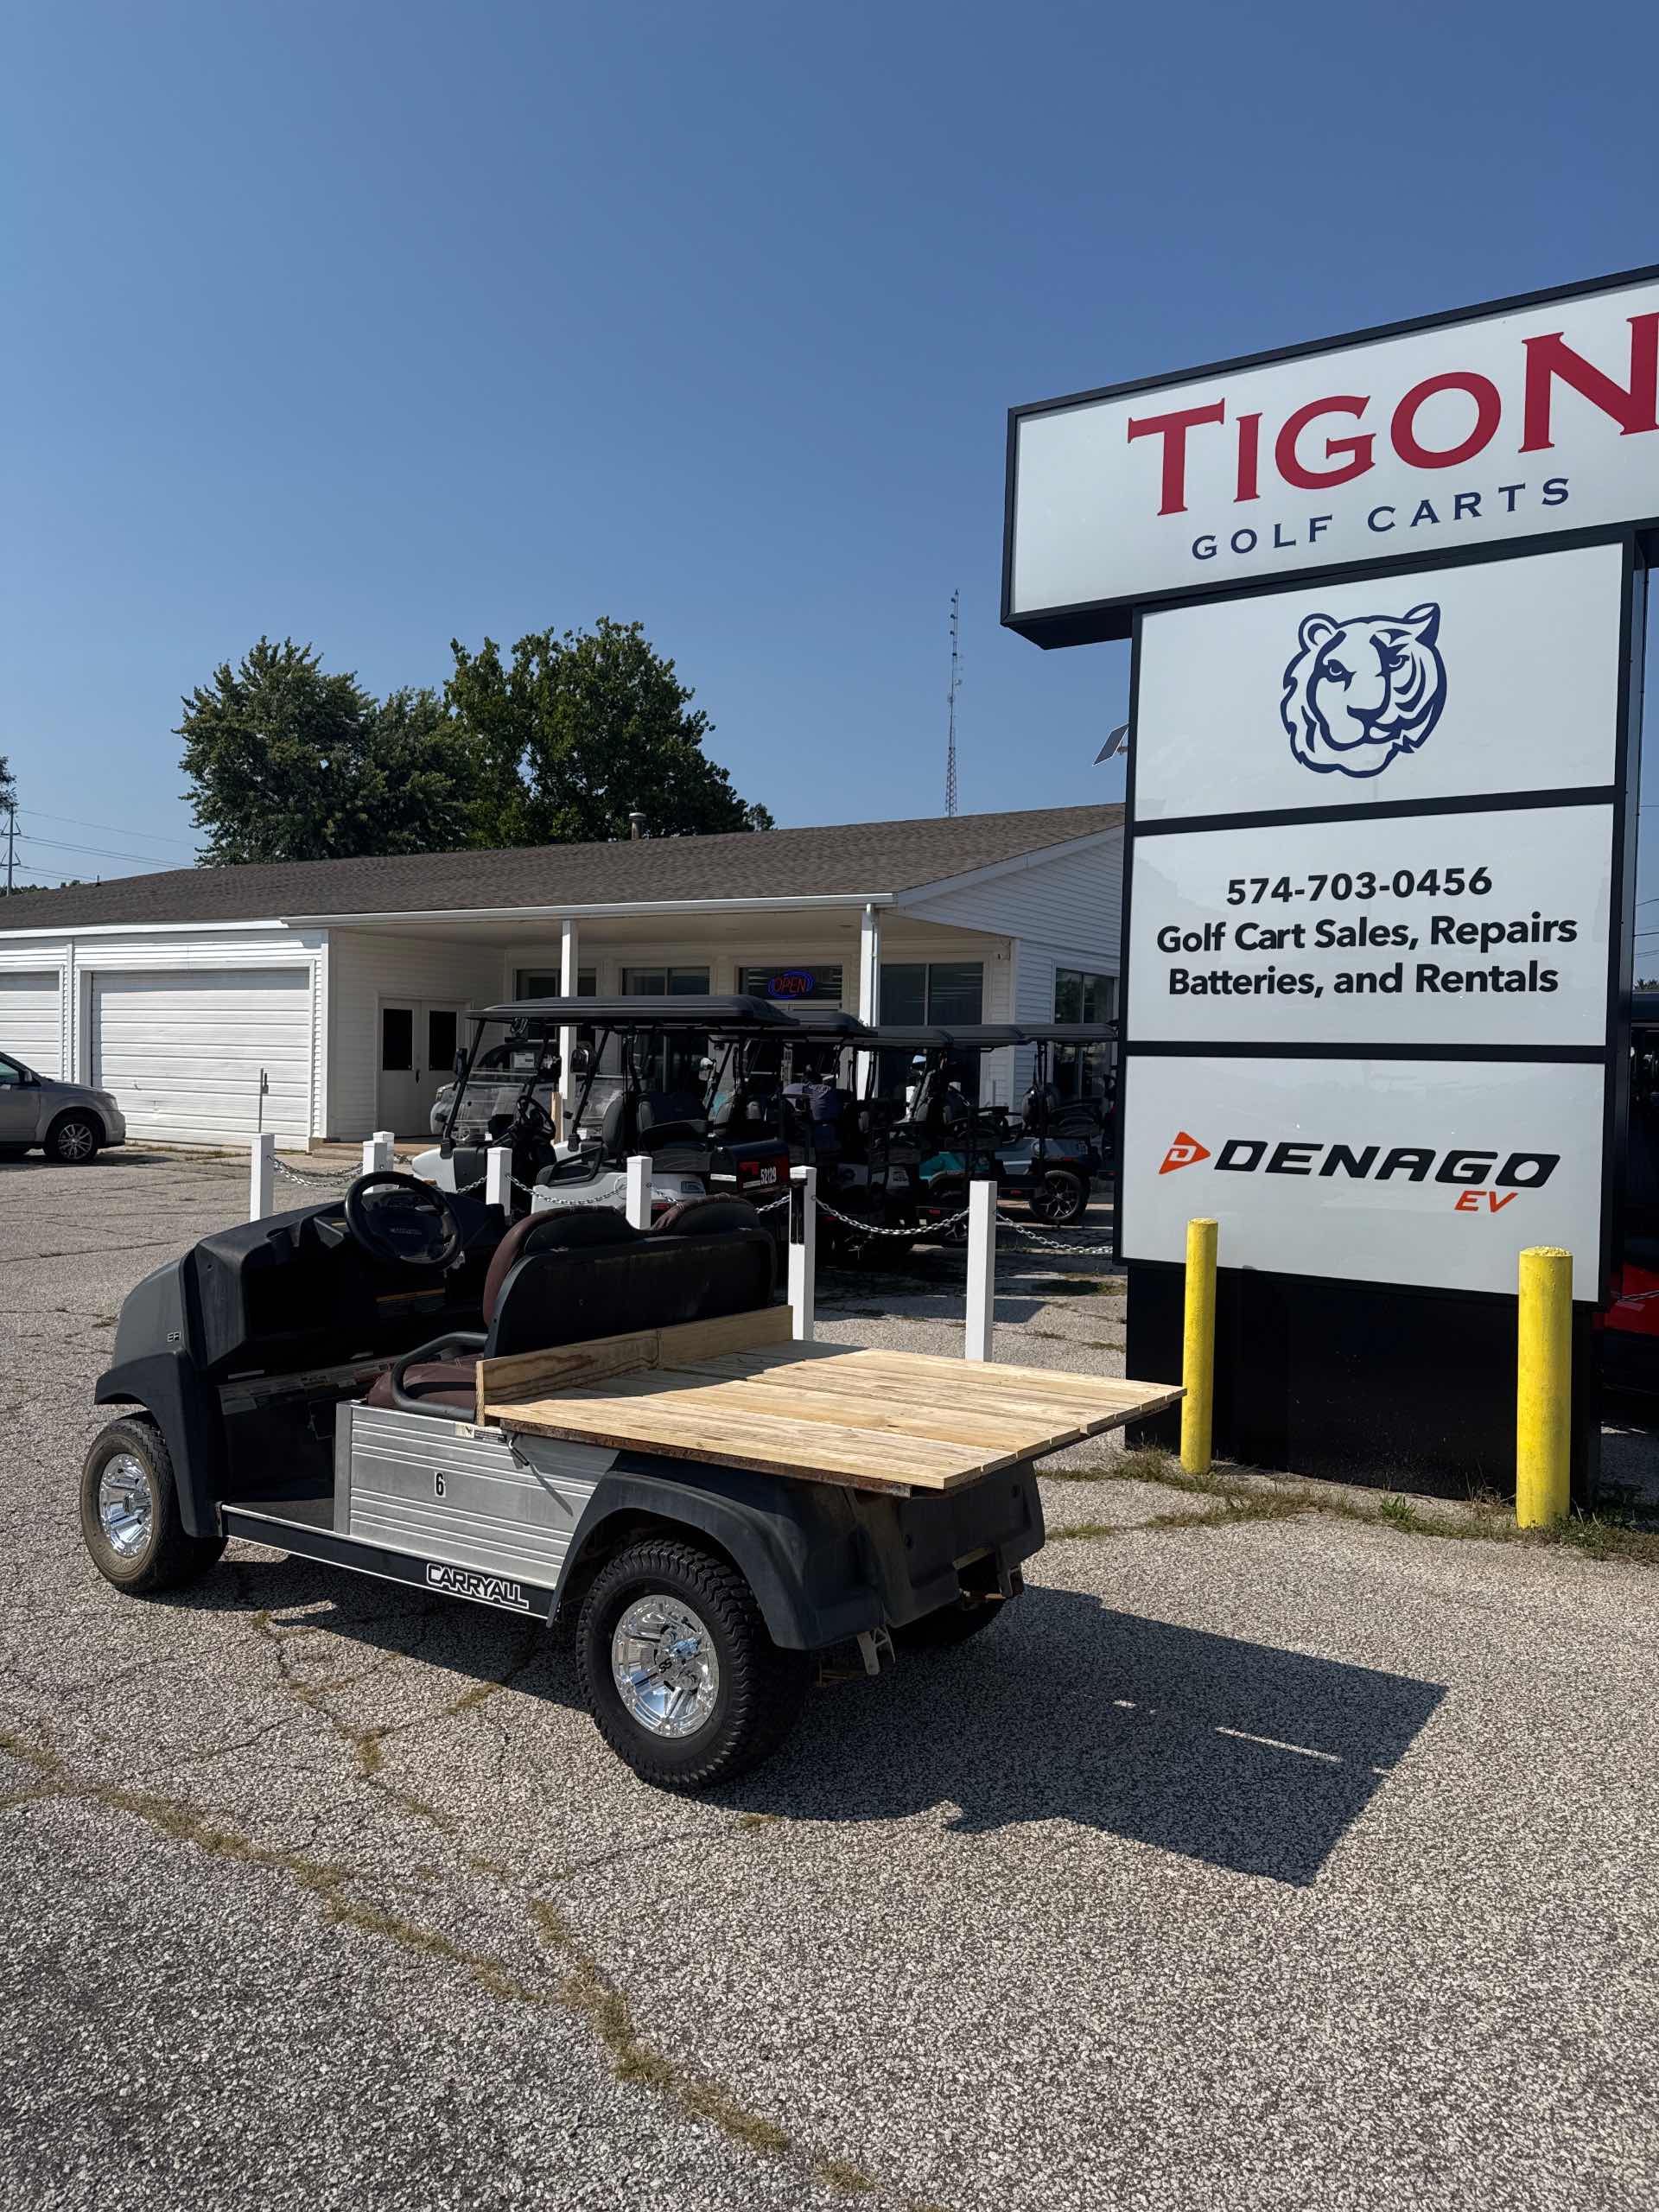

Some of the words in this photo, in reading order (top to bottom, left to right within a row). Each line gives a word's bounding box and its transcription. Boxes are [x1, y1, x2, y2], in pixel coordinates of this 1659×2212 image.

[1128, 312, 1659, 516] TIGON
[1192, 514, 1334, 561] GOLF
[1367, 477, 1571, 534] CARTS
[1226, 866, 1493, 906] 574-703-0456
[1156, 921, 1227, 954] Golf
[1234, 922, 1306, 951] Cart
[1313, 916, 1420, 951] Sales,
[1430, 911, 1579, 954] Repairs
[774, 977, 807, 993] OPEN
[1168, 964, 1325, 999] Batteries,
[1333, 962, 1404, 995] and
[1415, 959, 1560, 993] Rentals
[1213, 1139, 1561, 1189] DENAGO
[1454, 1190, 1518, 1213] EV
[435, 1472, 444, 1496] 6
[427, 1563, 529, 1610] CARRYALL
